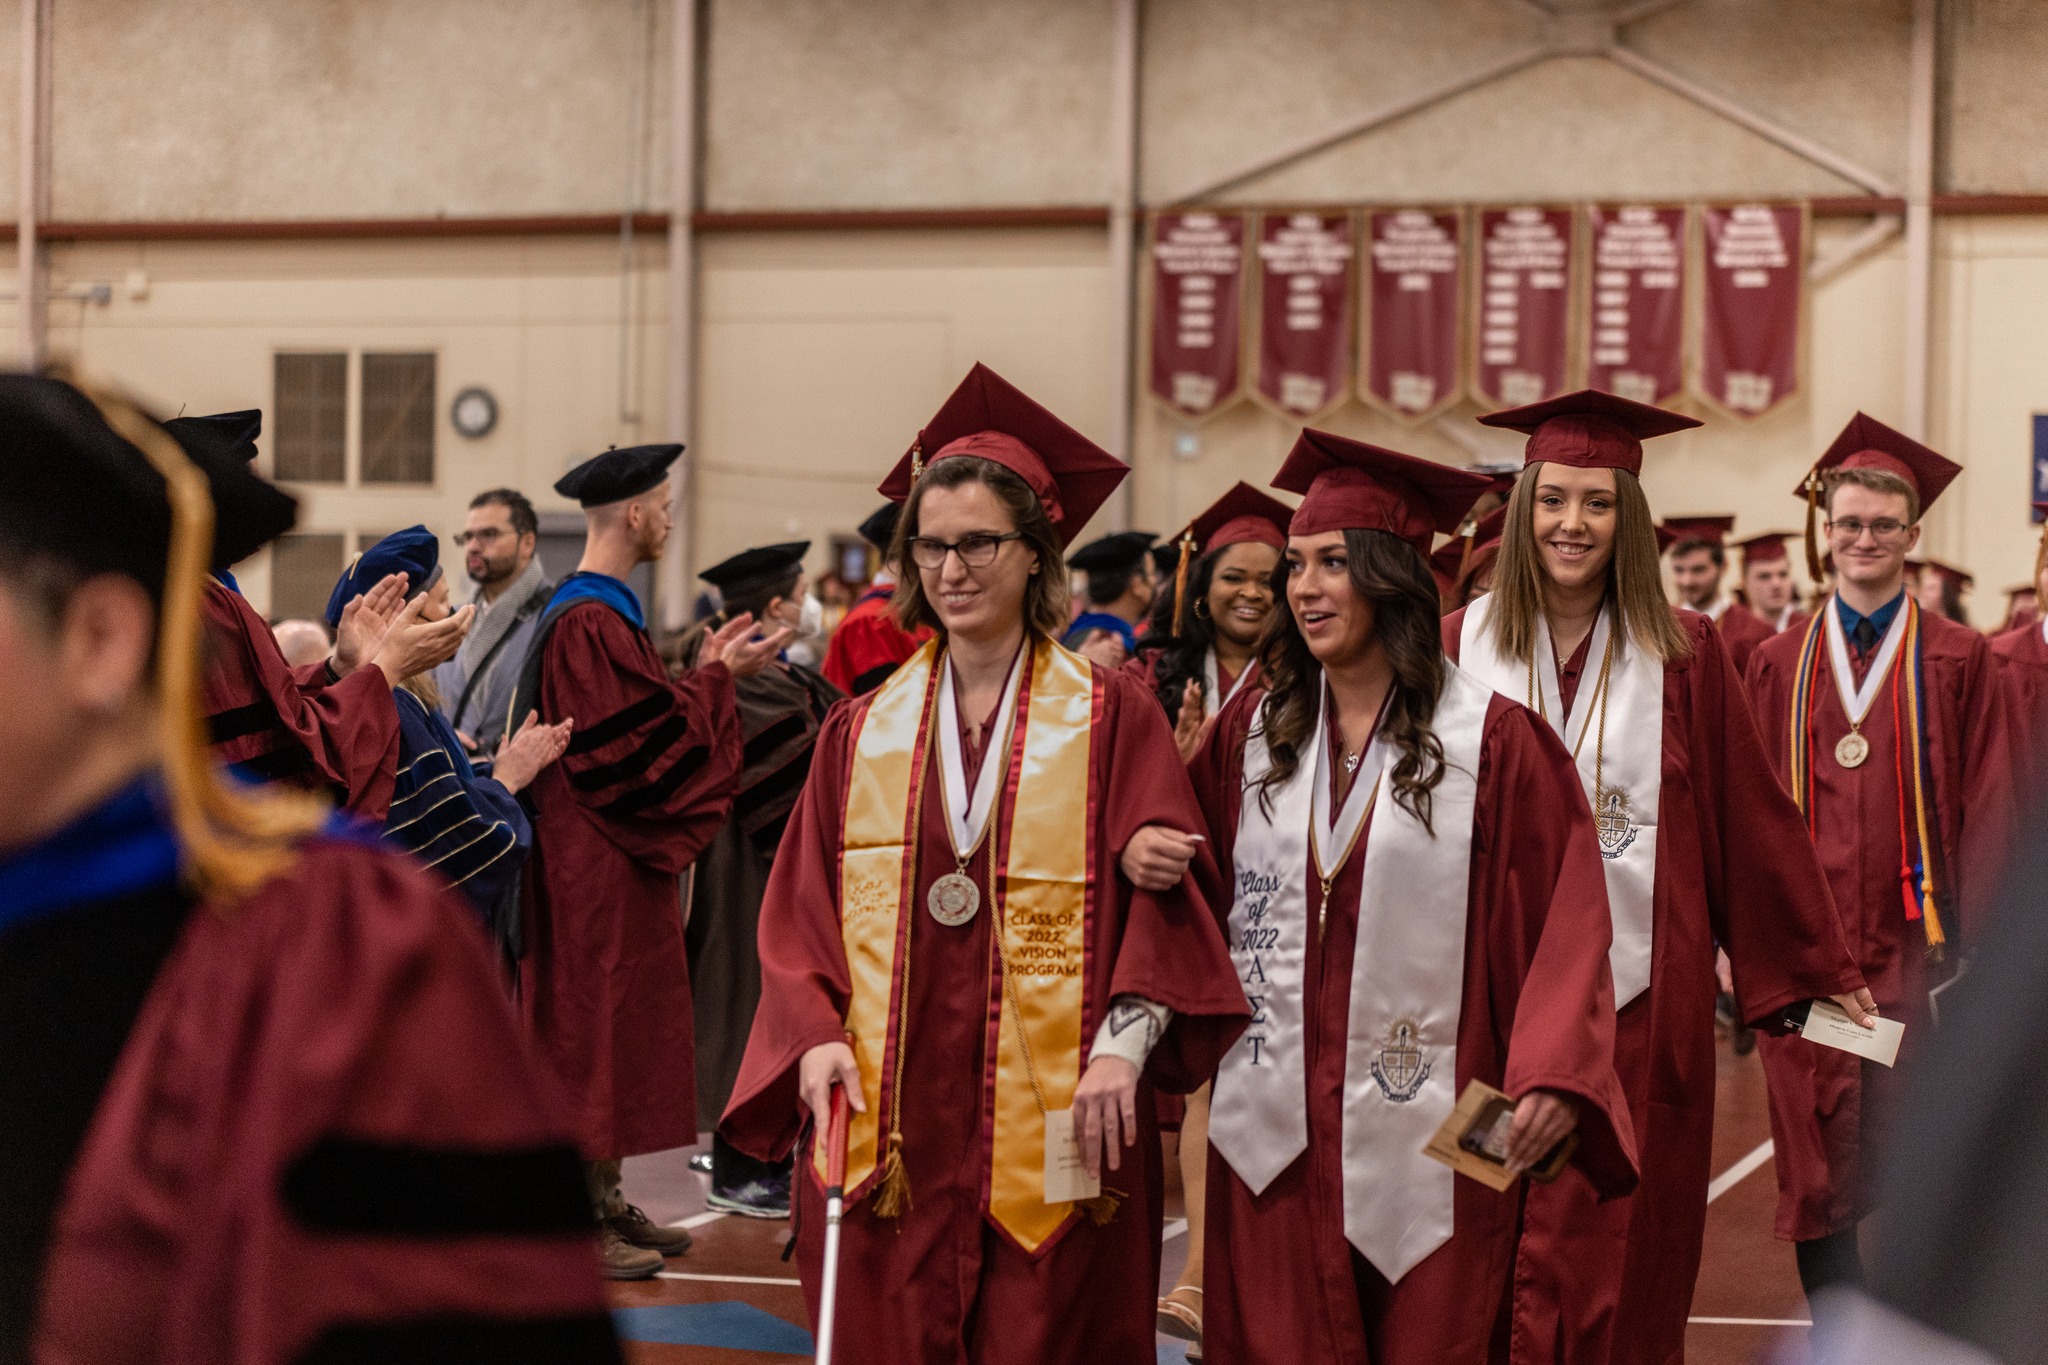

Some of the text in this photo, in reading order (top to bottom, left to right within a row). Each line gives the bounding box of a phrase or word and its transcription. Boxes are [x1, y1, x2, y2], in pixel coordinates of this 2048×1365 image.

[1241, 870, 1281, 895] Class
[1248, 896, 1267, 926] of
[1011, 913, 1076, 926] CLASS OF
[1027, 931, 1061, 943] 2022
[1241, 928, 1279, 951] 2022
[1020, 948, 1066, 960] VISION
[1009, 965, 1078, 977] PROGRAM
